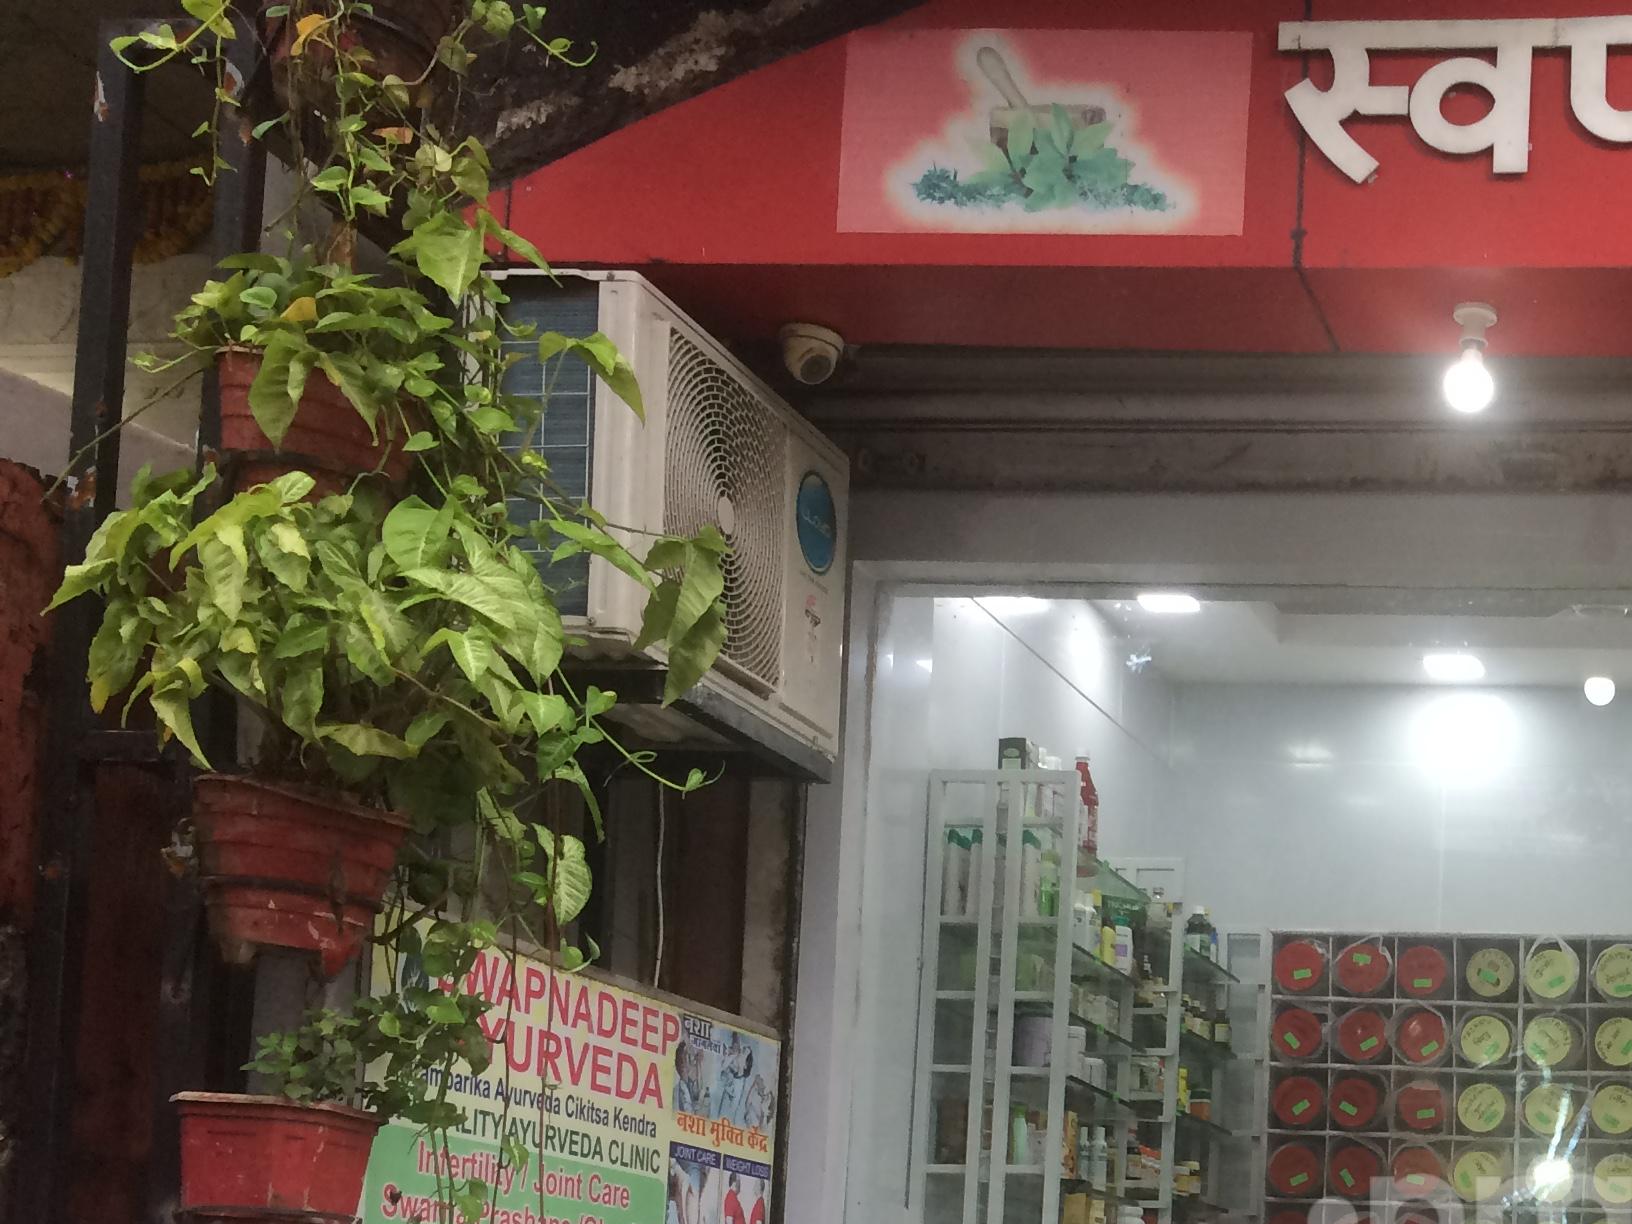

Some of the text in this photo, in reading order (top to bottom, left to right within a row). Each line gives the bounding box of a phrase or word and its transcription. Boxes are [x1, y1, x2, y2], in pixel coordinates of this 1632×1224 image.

[438, 951, 680, 1056] WAPNADEEP
[477, 1013, 664, 1109] YURVEDA
[566, 1095, 609, 1127] Cikitsa
[613, 1109, 657, 1138] Kendra
[677, 1112, 706, 1136] नशा
[608, 1140, 661, 1174] CLINIC
[675, 1146, 716, 1166] JOINT CARE
[588, 1174, 631, 1208] Care
